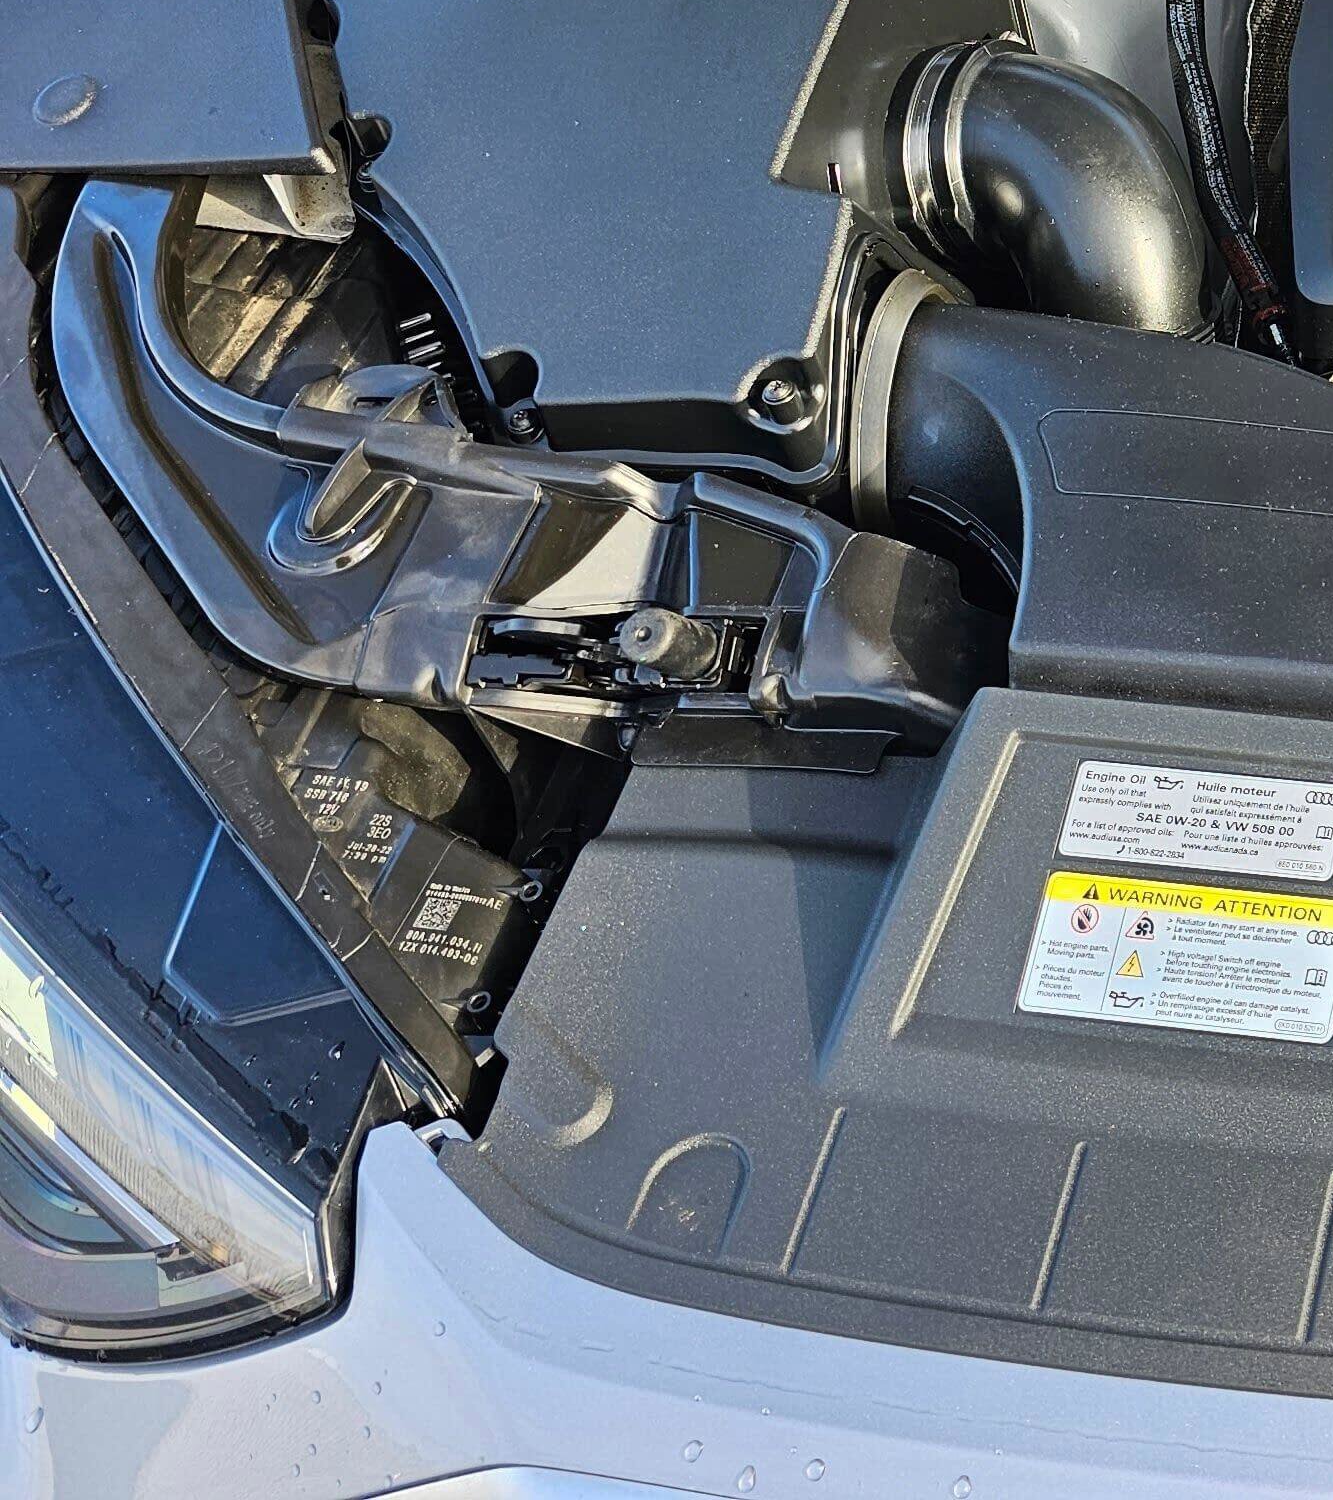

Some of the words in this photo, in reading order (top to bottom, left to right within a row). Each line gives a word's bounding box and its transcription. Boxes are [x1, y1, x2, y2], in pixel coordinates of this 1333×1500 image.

[312, 775, 336, 786] SAE
[1085, 770, 1126, 784] Engine
[1130, 774, 1146, 784] Oil
[1081, 784, 1096, 792] Use
[1098, 786, 1115, 795] only
[1118, 787, 1128, 795] oil
[1130, 789, 1146, 797] that
[1196, 781, 1226, 792] Huile
[1230, 785, 1276, 797] moteur
[319, 803, 340, 815] 12V
[1078, 795, 1114, 806] expressly
[1116, 799, 1152, 809] complies
[1154, 802, 1171, 810] with
[1192, 795, 1221, 804] Utilisez
[1222, 798, 1271, 811] uniquement
[1273, 802, 1283, 810] de
[369, 814, 392, 826] 22S
[1189, 806, 1203, 815] qui
[1205, 807, 1236, 817] satisfait
[1238, 810, 1295, 823] expressément
[1071, 819, 1085, 827] For
[1093, 821, 1106, 829] list
[1107, 822, 1116, 830] of
[1117, 823, 1156, 835] approved
[1135, 812, 1162, 823] SAE
[1165, 815, 1206, 827] 0W-20
[1210, 819, 1221, 828] &
[1225, 821, 1249, 831] VW
[1251, 823, 1275, 834] 508
[1278, 826, 1294, 836] 00
[1069, 830, 1140, 844] www.audiusa.com
[1183, 830, 1203, 839] Pour
[1221, 834, 1238, 842] liste
[1180, 841, 1259, 855] www.audicanada.ca
[485, 897, 503, 910] AE
[1107, 887, 1203, 911] WARNING
[1213, 899, 1322, 922] ATTENTION
[1175, 917, 1207, 926] Radiator
[1221, 923, 1236, 931] may
[1184, 926, 1222, 936] ventilateur
[1224, 931, 1240, 939] peut
[1046, 948, 1074, 958] Moving
[1062, 942, 1089, 951] engine
[1165, 958, 1189, 966] before
[1191, 961, 1223, 971] touching
[1224, 965, 1249, 974] engine
[1167, 950, 1185, 958] High
[1217, 955, 1242, 964] Switch
[1255, 960, 1281, 969] engine
[1067, 966, 1077, 974] du
[1078, 968, 1104, 977] moteur
[1164, 966, 1185, 974] Haute
[1253, 976, 1280, 985] moteur
[1195, 978, 1222, 987] toucher
[1159, 990, 1195, 1001] Overfilled
[1195, 996, 1221, 1006] engine
[1248, 1001, 1278, 1011] damage
[1169, 1000, 1214, 1012] remplissage
[1215, 1006, 1245, 1015] excessif
[1155, 1008, 1172, 1016] peut
[1173, 1010, 1192, 1018] nuire
